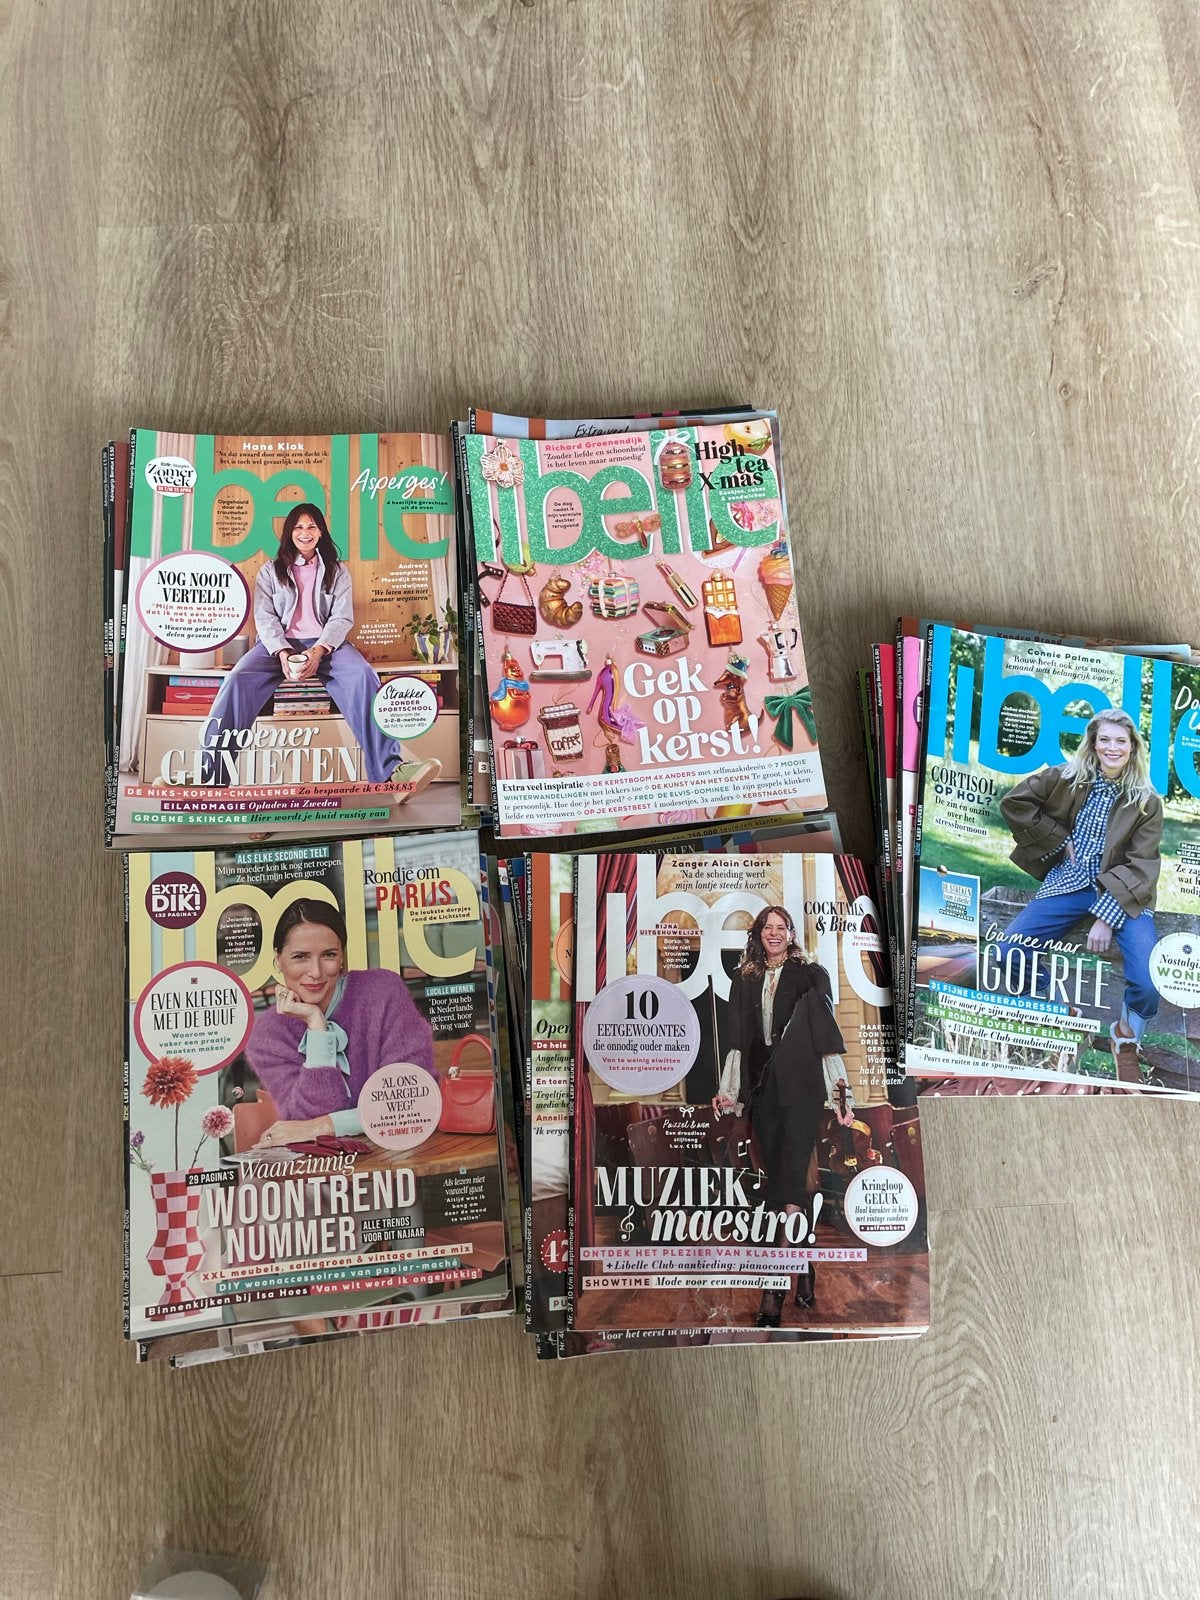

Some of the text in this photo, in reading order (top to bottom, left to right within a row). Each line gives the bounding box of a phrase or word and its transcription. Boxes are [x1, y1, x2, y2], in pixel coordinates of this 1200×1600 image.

[546, 436, 643, 451] Richard Groenendijk
[694, 439, 745, 464] High
[148, 464, 194, 478] Zomer
[735, 458, 770, 474] tea
[154, 476, 190, 487] week
[351, 468, 448, 499] Asperges!
[696, 472, 763, 491] X-mas
[158, 571, 232, 587] NOG NOOIT
[163, 588, 225, 603] VERTELD
[1028, 648, 1101, 663] Connie Palmen
[623, 656, 709, 698] Gek
[1006, 663, 1090, 680] iemand belangrijk
[383, 685, 426, 699] Strakker
[653, 694, 701, 734] op
[198, 717, 320, 748] Groener
[637, 714, 763, 765] kerst!
[160, 747, 361, 786] GENIETEN
[503, 771, 696, 791] Extra inspiratie KERSTBOOM ANDERS
[932, 766, 997, 796] CORTISOL
[147, 788, 296, 797] NIKS-KOPEN-CHALLENGE
[315, 785, 359, 795] bespaarde
[504, 791, 588, 801] WINTERWANDELINGEN
[935, 784, 992, 805] OP HOL?
[164, 799, 338, 811] EILANDMAGIE Opladen Zweden
[609, 788, 797, 813] KERSTBEST KERSTNAGELS
[274, 812, 300, 820] wordt
[315, 810, 336, 819] huid
[340, 810, 366, 819] rustig
[755, 817, 783, 827] klanten
[935, 818, 987, 835] stresshormoon
[237, 848, 328, 863] ALS ELKE SECONDE TELT
[672, 861, 708, 869] Zanger
[364, 867, 440, 885] Rondje om
[152, 884, 200, 894] EXTRA
[695, 881, 742, 891] lontje steeds
[152, 894, 200, 912] DIK!
[376, 880, 451, 911] PARIJS
[804, 901, 864, 916] COCKTAILS
[816, 916, 856, 936] & Bites
[985, 923, 1082, 953] Ga mee naar
[909, 959, 917, 991] september
[983, 944, 1111, 1009] GOEREE
[151, 988, 238, 1010] EVEN KLETSEN
[426, 985, 474, 996] LUCILLE WERNER
[625, 990, 659, 1020] 10
[971, 991, 1067, 1014] LOGEERADRESSEN
[154, 1008, 236, 1030] MET DE BUUF
[949, 1011, 1082, 1041] RONDJE OVER HET EILAND
[1055, 1017, 1098, 1030] bewoners
[597, 1024, 686, 1037] EETGEWOONTES
[593, 1039, 690, 1054] die onnodig ouder maken
[990, 1031, 1075, 1053] Club-aanbiedingen
[371, 1087, 429, 1101] SPAARGELD
[388, 1128, 409, 1136] SLIMME
[240, 1151, 357, 1181] Waanzinnig
[189, 1170, 234, 1185] 29 PAGINA'S
[862, 1179, 903, 1192] Kringloop
[594, 1167, 751, 1207] MUZIEK
[205, 1168, 416, 1228] WOONTREND
[865, 1193, 899, 1205] GELUK
[363, 1217, 409, 1230] ALLE TRENDS
[651, 1193, 823, 1243] maestro!
[227, 1216, 356, 1264] NUMMER
[363, 1228, 425, 1242] VOOR DIT NAJAAR
[583, 1249, 631, 1257] ONTDEK
[636, 1249, 656, 1257] HET
[663, 1249, 711, 1257] PLEZIER
[717, 1249, 740, 1257] VAN
[746, 1250, 813, 1258] KLASSIEKE
[203, 1245, 470, 1281] XXL vintage mix
[615, 1260, 805, 1271] Libelle Club-aanbieding: pianoconcert
[219, 1258, 458, 1291] DIY woonaccessoires papier-maché
[585, 1277, 787, 1288] SHOWTIME Mode voor avondje uit
[149, 1278, 393, 1315] Binnenkijken Hoes werd
[526, 1302, 531, 1312] 47
[568, 1302, 574, 1312] 37
